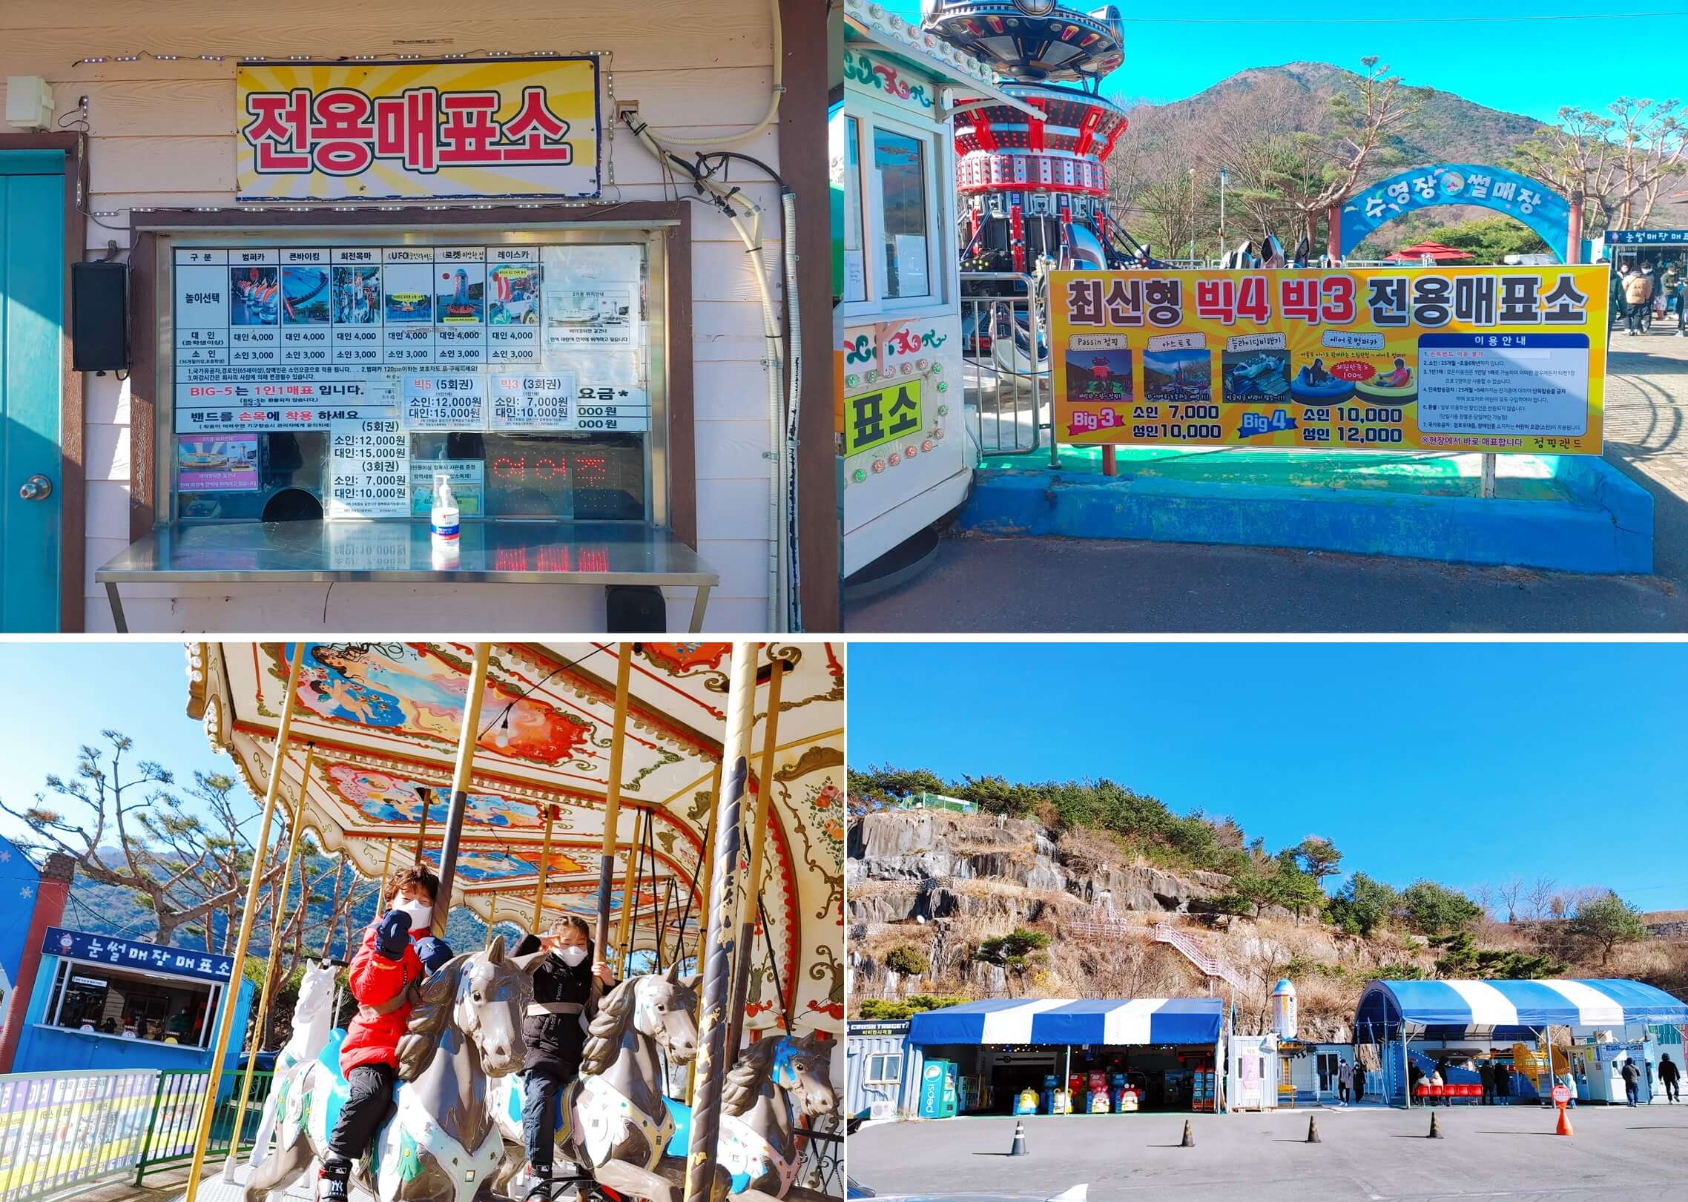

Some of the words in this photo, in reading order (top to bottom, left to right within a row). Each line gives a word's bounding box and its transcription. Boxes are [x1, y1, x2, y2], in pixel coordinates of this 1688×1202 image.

[247, 89, 570, 174] 전용매표소
[1365, 178, 1438, 219] 수영장
[1467, 173, 1542, 215] 썰매장
[242, 253, 265, 261] 범퍼카
[341, 252, 371, 261] 회전목마
[498, 251, 529, 259] 레이스카
[185, 293, 220, 304] 놀이선택
[1067, 279, 1182, 326] 최신형
[1198, 277, 1270, 324] 빅4
[1282, 278, 1354, 323] 빅3
[1368, 275, 1588, 326] 전용매표소
[234, 333, 249, 341] 대인
[251, 333, 273, 342] 4,000
[285, 333, 301, 341] 대인
[303, 333, 325, 342] 4,000
[337, 333, 352, 341] 대인
[354, 333, 376, 342] 4,000
[388, 332, 403, 340] 대인
[405, 332, 428, 341] 4,000
[439, 332, 455, 340] 대인
[457, 332, 480, 341] 4,000
[492, 332, 508, 340] 대인
[510, 332, 533, 341] 4,000
[1162, 338, 1191, 347] 아스트로
[234, 351, 249, 359] 소인
[251, 351, 273, 360] 3,000
[285, 351, 301, 359] 소인
[303, 351, 325, 360] 3,000
[337, 351, 352, 359] 소인
[354, 351, 376, 360] 3,000
[388, 350, 403, 358] 소인
[405, 350, 428, 359] 3,000
[439, 350, 455, 358] 소인
[457, 350, 480, 359] 3,000
[492, 350, 508, 358] 소인
[510, 350, 533, 359] 3,000
[414, 379, 431, 390] 빅5
[436, 378, 473, 391] (5회권)
[501, 378, 519, 390] 빅3
[523, 378, 561, 391] (3회권)
[254, 385, 314, 396] 1인1매표
[319, 385, 364, 395] 입니다.
[410, 397, 482, 408] 소인:12,000원
[190, 411, 233, 422] 밴드를
[239, 411, 279, 421] 손목에
[285, 411, 313, 420] 착용
[409, 408, 481, 418] 대인:15,000원
[496, 407, 568, 418] 대인:10,000원
[1132, 406, 1159, 419] 소인
[1168, 404, 1220, 420] 7,000
[1302, 408, 1330, 422] 소인
[1337, 407, 1403, 424] 10,000
[1073, 411, 1098, 430] Big
[1242, 412, 1268, 432] Big
[362, 421, 400, 433] (5회권)
[1132, 424, 1159, 438] 성인
[1160, 424, 1222, 440] 10,000
[1302, 427, 1330, 442] 성인
[1337, 426, 1403, 443] 12,000
[334, 436, 406, 446] 소인:12,000원
[334, 448, 406, 459] 대인:15,000원
[362, 462, 400, 473] (3회권)
[334, 489, 406, 499] 대인:10,000원
[925, 1084, 935, 1113] pepsi
